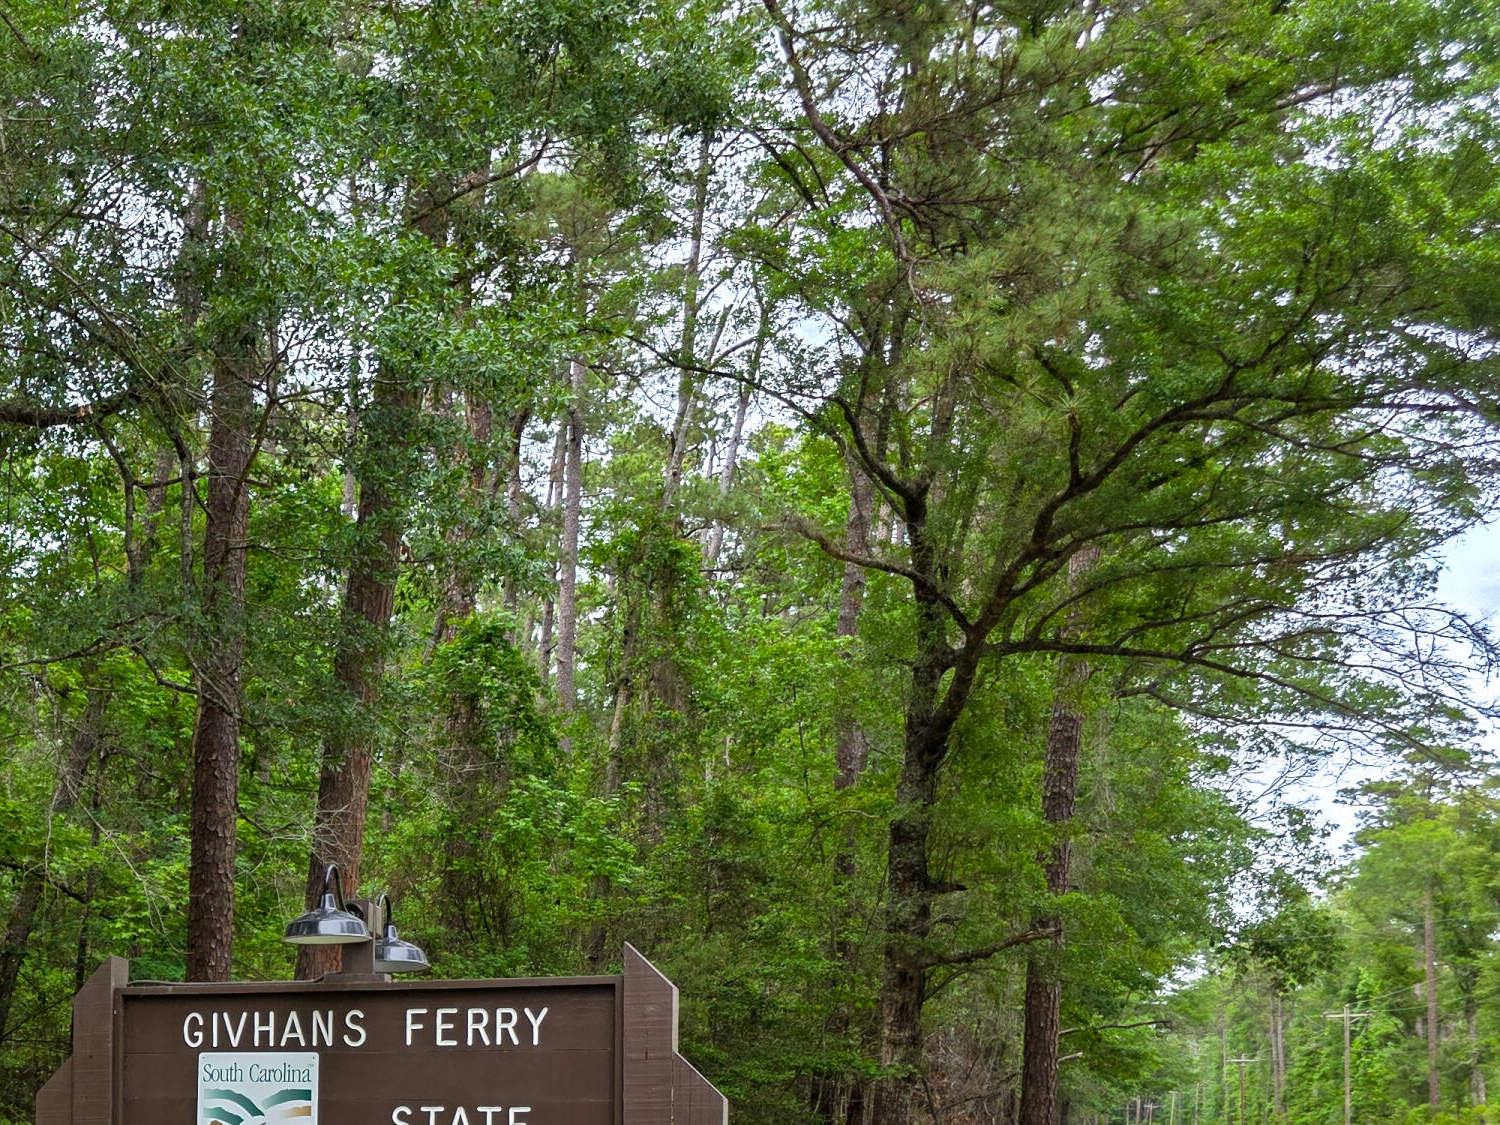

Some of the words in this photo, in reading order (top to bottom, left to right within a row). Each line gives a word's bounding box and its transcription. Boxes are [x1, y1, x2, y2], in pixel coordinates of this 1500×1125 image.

[183, 1010, 367, 1048] GIVHANS
[405, 1007, 549, 1047] FERRY
[202, 1061, 244, 1084] South
[249, 1062, 312, 1084] Carolina
